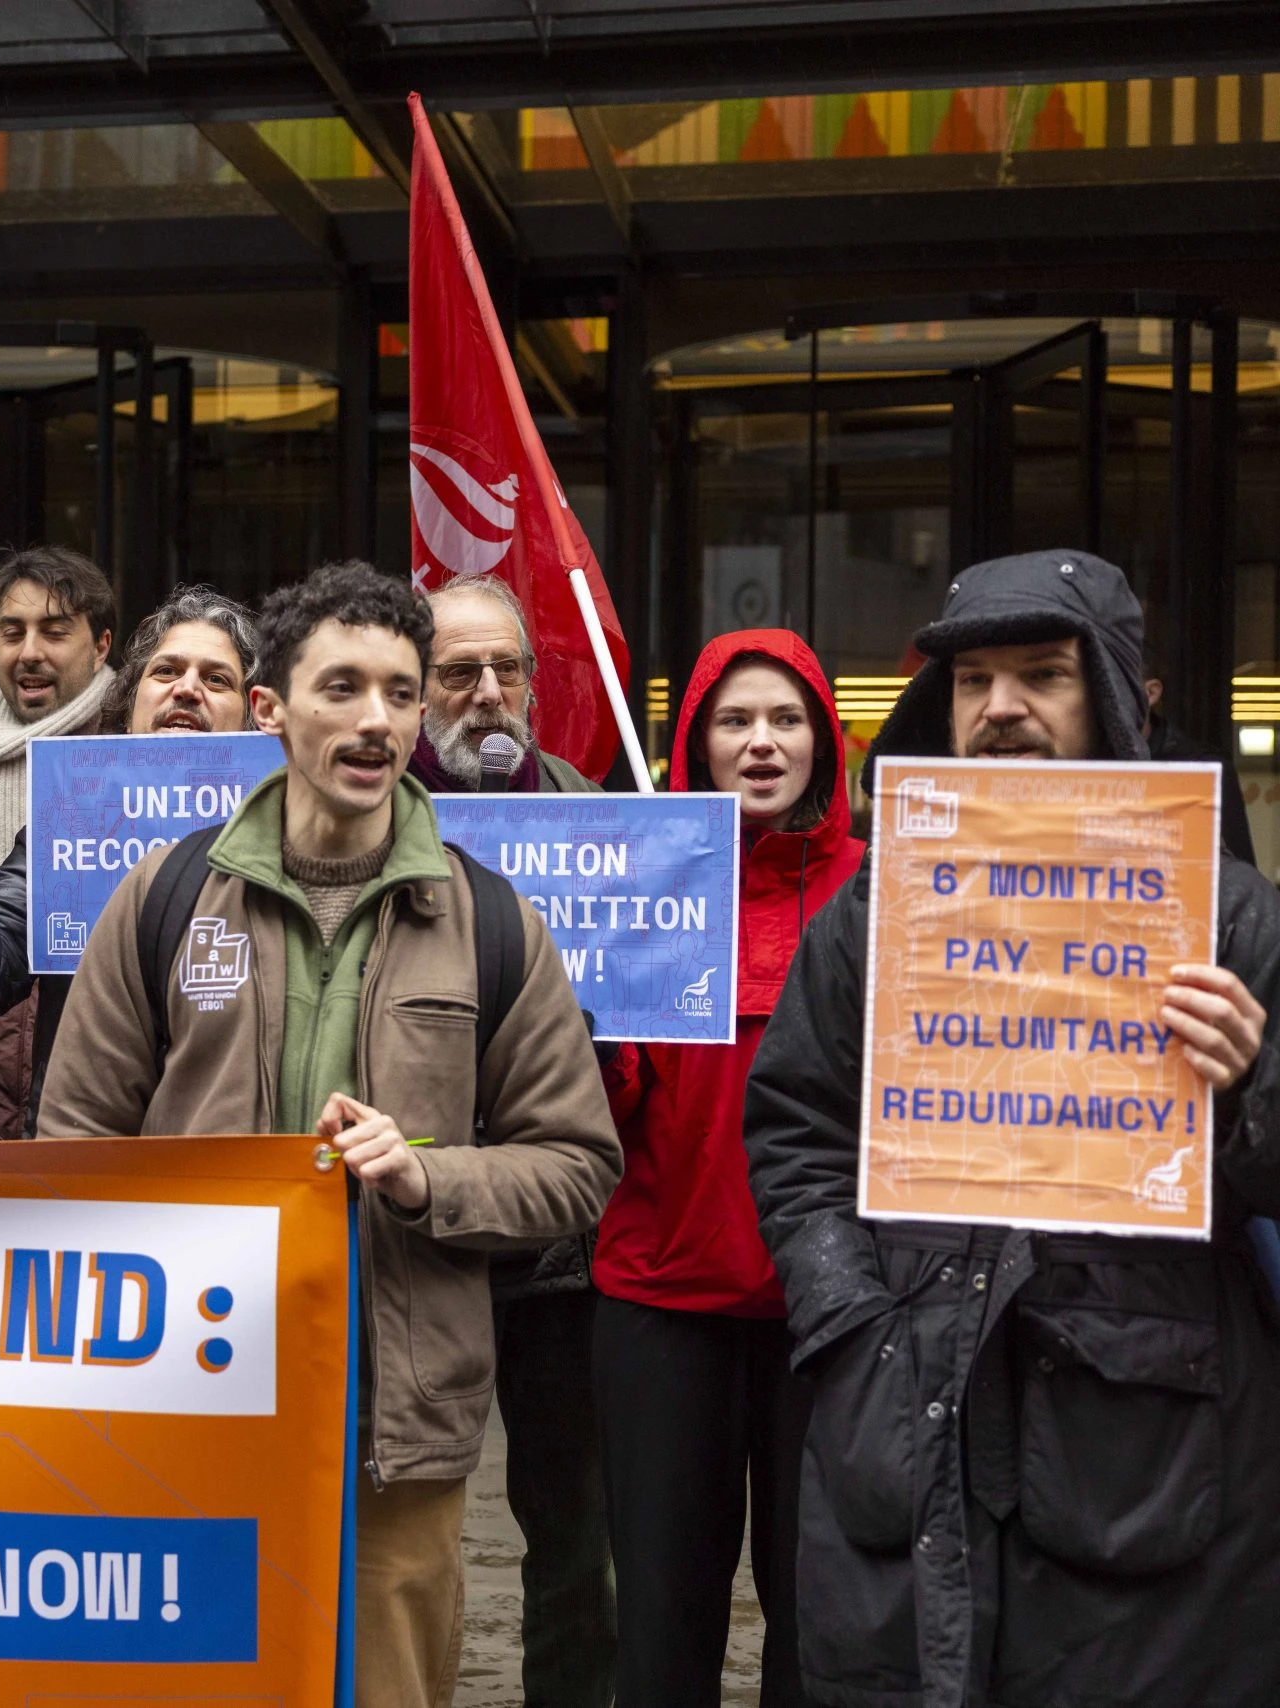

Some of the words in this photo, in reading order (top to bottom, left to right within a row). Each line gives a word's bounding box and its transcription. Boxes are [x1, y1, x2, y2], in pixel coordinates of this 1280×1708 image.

[122, 785, 242, 819] UNION
[500, 842, 628, 877] UNION
[932, 862, 958, 896] 6
[988, 864, 1166, 902] MONTHS
[944, 937, 1030, 974] PAY
[1062, 942, 1148, 978] FOR
[913, 1011, 1175, 1056] VOLUNTARY
